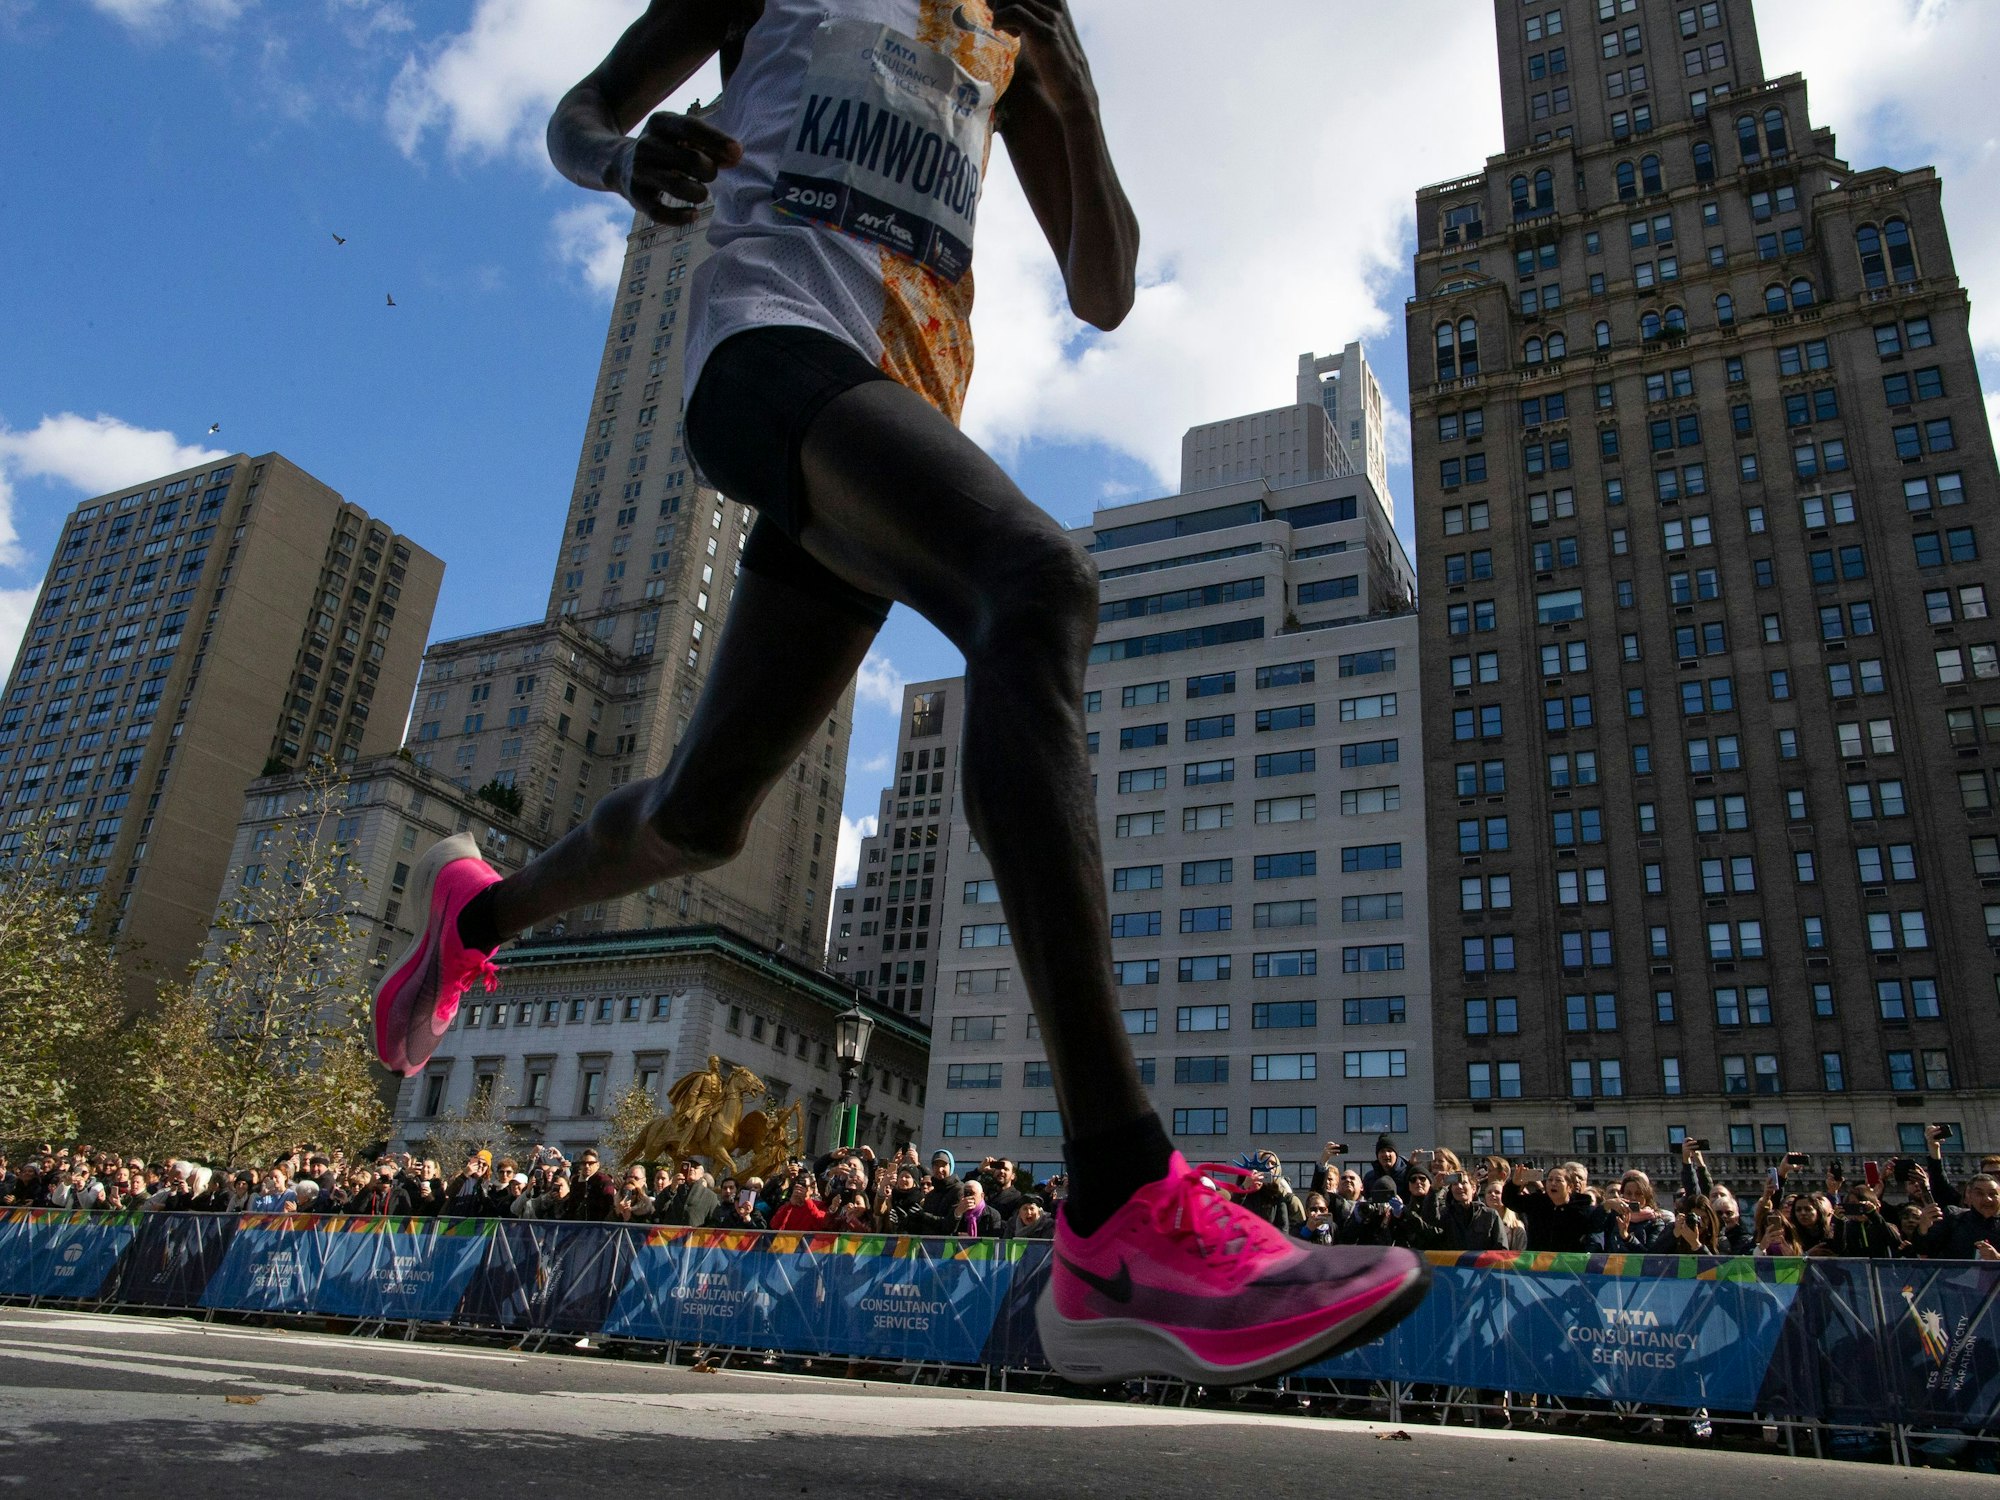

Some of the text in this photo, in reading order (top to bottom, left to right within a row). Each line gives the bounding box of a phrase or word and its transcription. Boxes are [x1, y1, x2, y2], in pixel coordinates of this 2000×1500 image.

[885, 39, 917, 64] TATA
[870, 62, 920, 95] SVICES
[796, 94, 978, 226] KAMWOROR
[785, 186, 837, 210] 2019
[267, 1251, 292, 1262] TATA
[394, 1255, 417, 1267] TATA
[54, 1265, 76, 1276] TATA
[249, 1264, 304, 1276] CONSTANCY
[696, 1272, 728, 1286] TATA
[671, 1286, 747, 1303] CONSULTANCY
[883, 1283, 921, 1297] TATA
[682, 1302, 734, 1318] SERVICES
[860, 1298, 947, 1315] CONSULTANCY
[873, 1315, 929, 1331] SERVICES
[1603, 1308, 1659, 1327] TATA
[1567, 1326, 1699, 1350] CONSULTANCY
[1592, 1348, 1676, 1369] SERVICES
[1940, 1315, 1969, 1390] NEW YORK CITY
[1953, 1334, 1977, 1391] MARATHON
[1926, 1370, 1939, 1389] TCS
